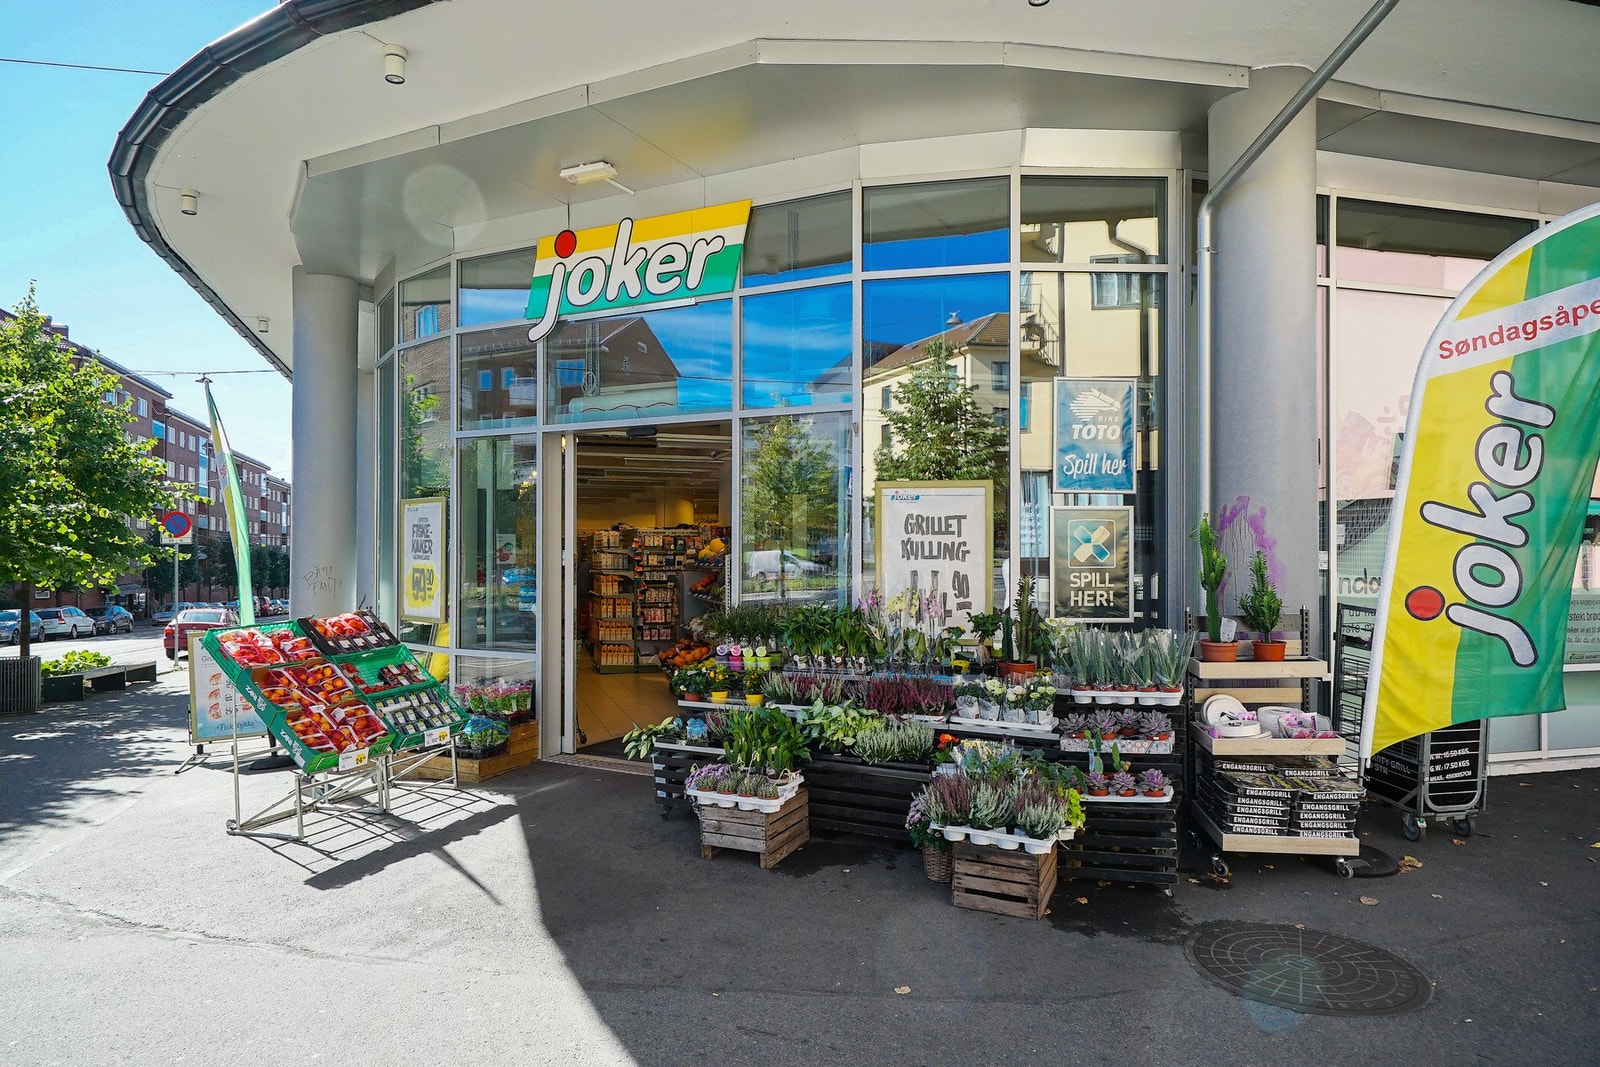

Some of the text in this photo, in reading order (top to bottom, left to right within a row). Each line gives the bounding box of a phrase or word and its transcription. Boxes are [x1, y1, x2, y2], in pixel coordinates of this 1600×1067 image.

[527, 217, 726, 343] joker
[1071, 424, 1122, 440] TOTO
[1063, 453, 1128, 479] Spill her
[904, 513, 968, 538] GRILLET
[1404, 369, 1556, 668] joker
[411, 539, 433, 555] KAKER
[900, 537, 971, 562] KYLLING
[1069, 572, 1115, 588] SPILL
[1070, 590, 1115, 607] HER!
[1222, 763, 1267, 772] ENGANGSGRILL
[1246, 789, 1292, 798] ENGANGSGRILL
[1237, 797, 1283, 807] ENGANGSGRILL
[1236, 807, 1283, 816] ENGANGSGRILL
[1299, 812, 1346, 820] ENGANGSGRILL
[1233, 816, 1280, 826] ENGANGSGRILL
[1232, 826, 1279, 835] ENGANGSGRILL
